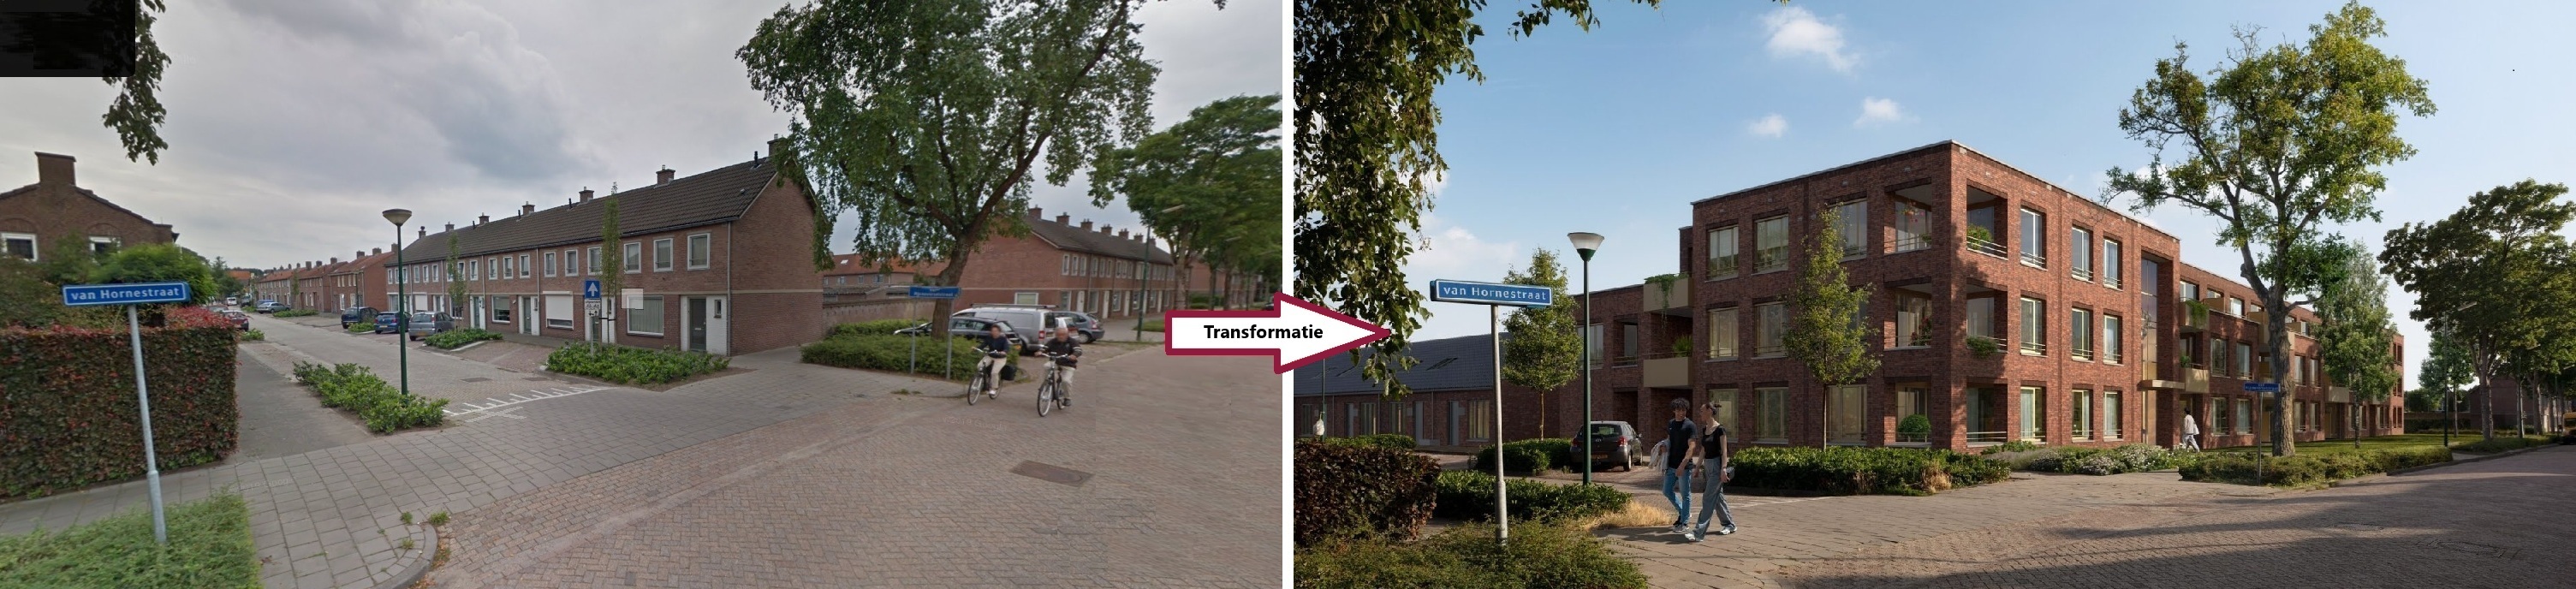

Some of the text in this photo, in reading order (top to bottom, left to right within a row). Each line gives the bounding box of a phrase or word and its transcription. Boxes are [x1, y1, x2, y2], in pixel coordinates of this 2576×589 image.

[71, 288, 180, 300] van Hornestraat
[1443, 287, 1546, 300] van Hornestraat
